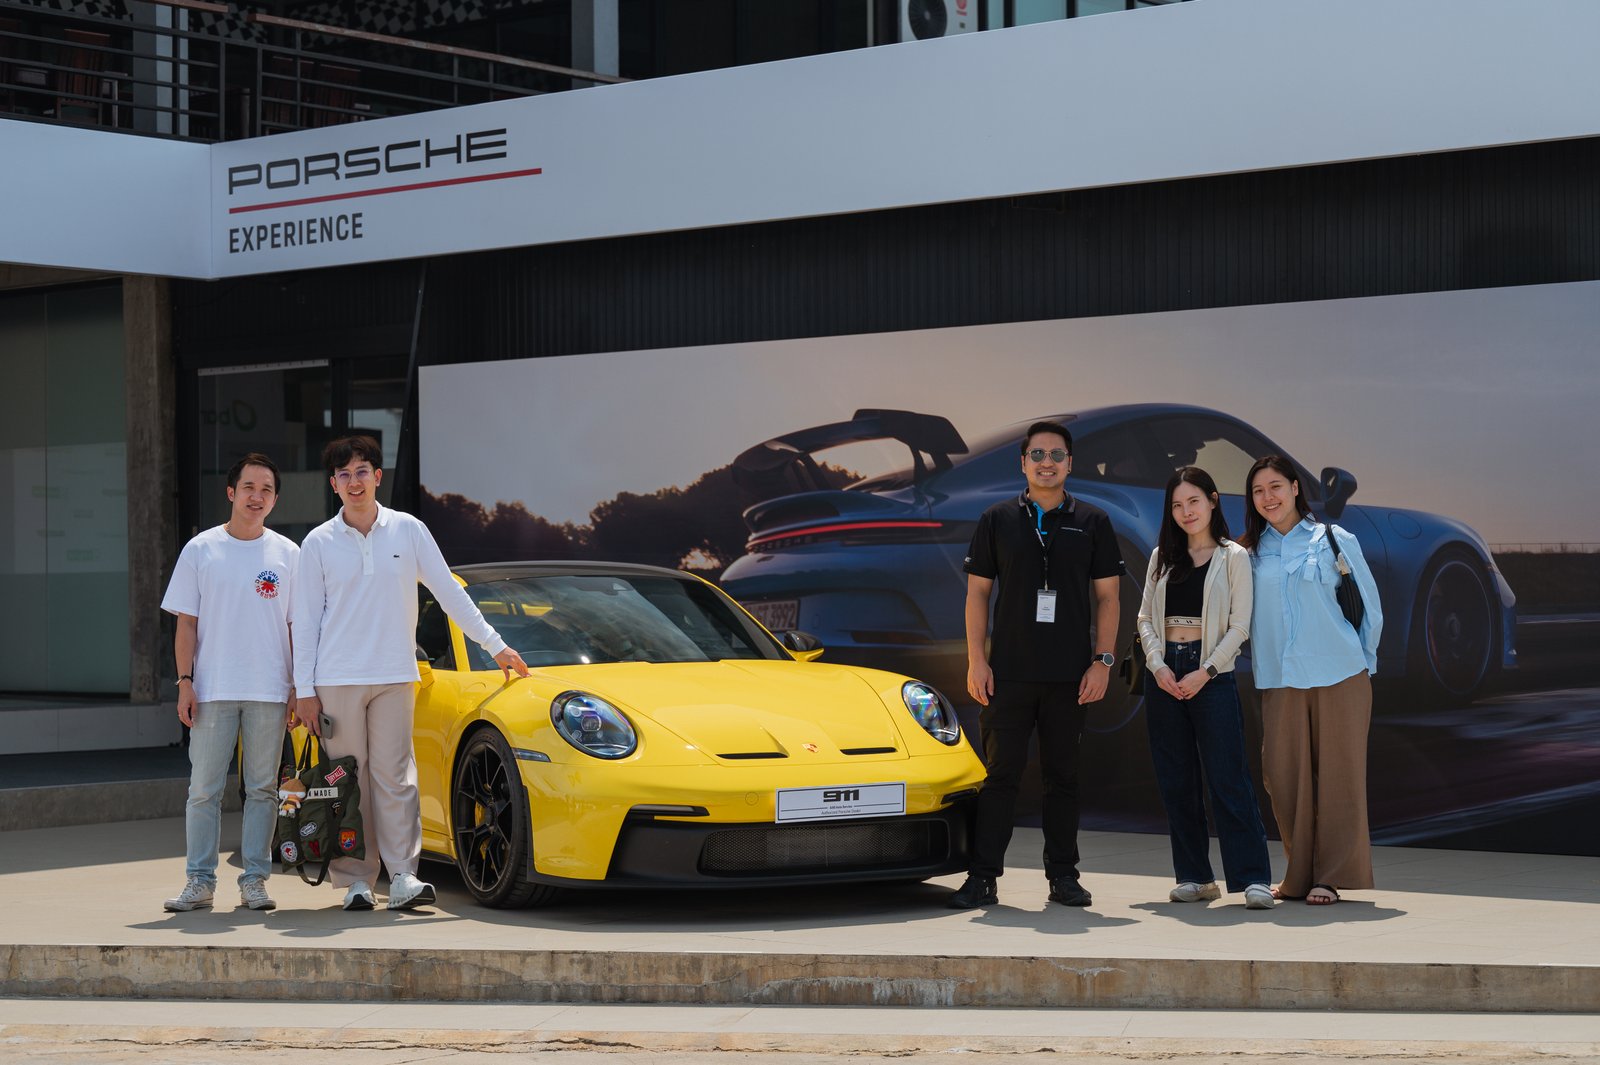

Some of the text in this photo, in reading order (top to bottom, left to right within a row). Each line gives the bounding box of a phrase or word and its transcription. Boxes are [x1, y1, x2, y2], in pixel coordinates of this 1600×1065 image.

[228, 128, 507, 195] PORSCHE
[229, 212, 363, 254] EXPERIENCE
[257, 571, 267, 580] HOT
[313, 789, 332, 797] MADE
[824, 789, 859, 802] 911
